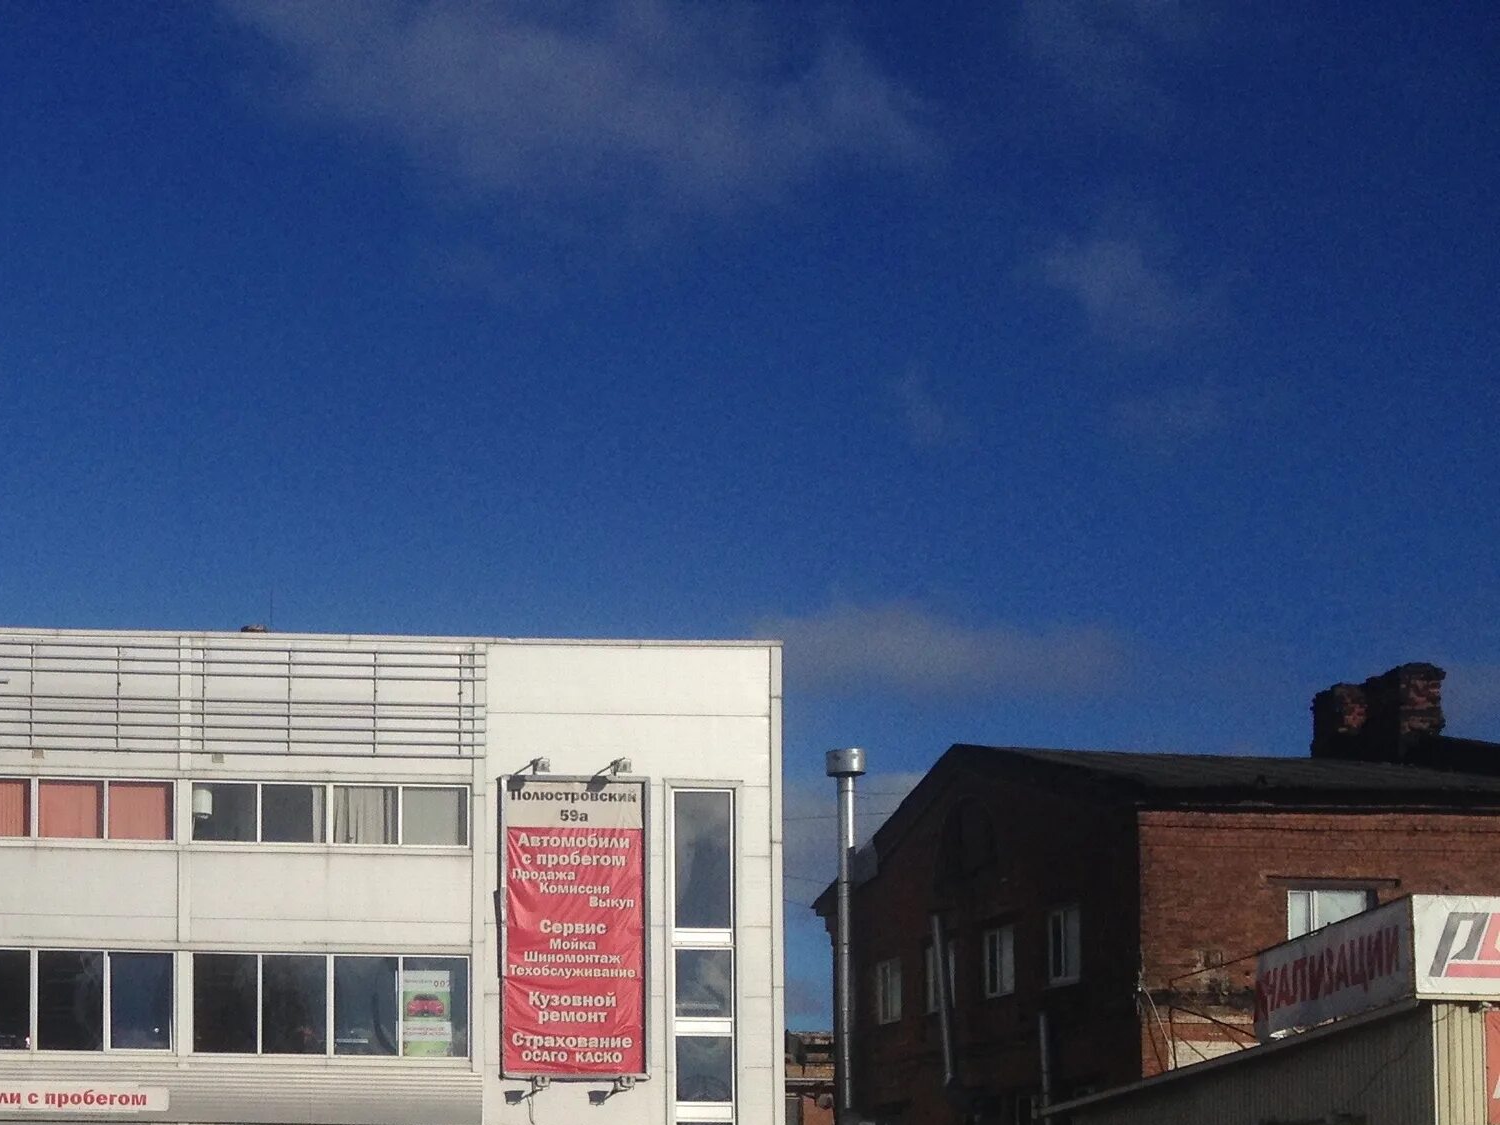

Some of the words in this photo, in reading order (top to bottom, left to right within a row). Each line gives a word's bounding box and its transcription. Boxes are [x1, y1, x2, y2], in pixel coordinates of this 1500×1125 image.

[510, 788, 638, 804] Полюстровский
[559, 809, 589, 822] 59а
[517, 832, 630, 849] Автомобили
[521, 853, 532, 865] с
[536, 850, 627, 867] пробегом
[512, 867, 576, 882] Продажа
[539, 881, 610, 895] Комиссия
[588, 896, 635, 909] Выкуп
[539, 919, 608, 936] Сервис
[549, 938, 597, 950] Мойка
[523, 950, 621, 965] Шиномонтаж
[509, 964, 637, 979] Техобслуживание
[528, 991, 617, 1010] Кузовной
[538, 1009, 608, 1025] ремонт
[511, 1032, 633, 1050] Страхование
[521, 1050, 568, 1063] ОСАГО
[575, 1051, 623, 1064] КАСКО
[27, 1092, 40, 1105] с
[44, 1088, 148, 1108] пробегом
